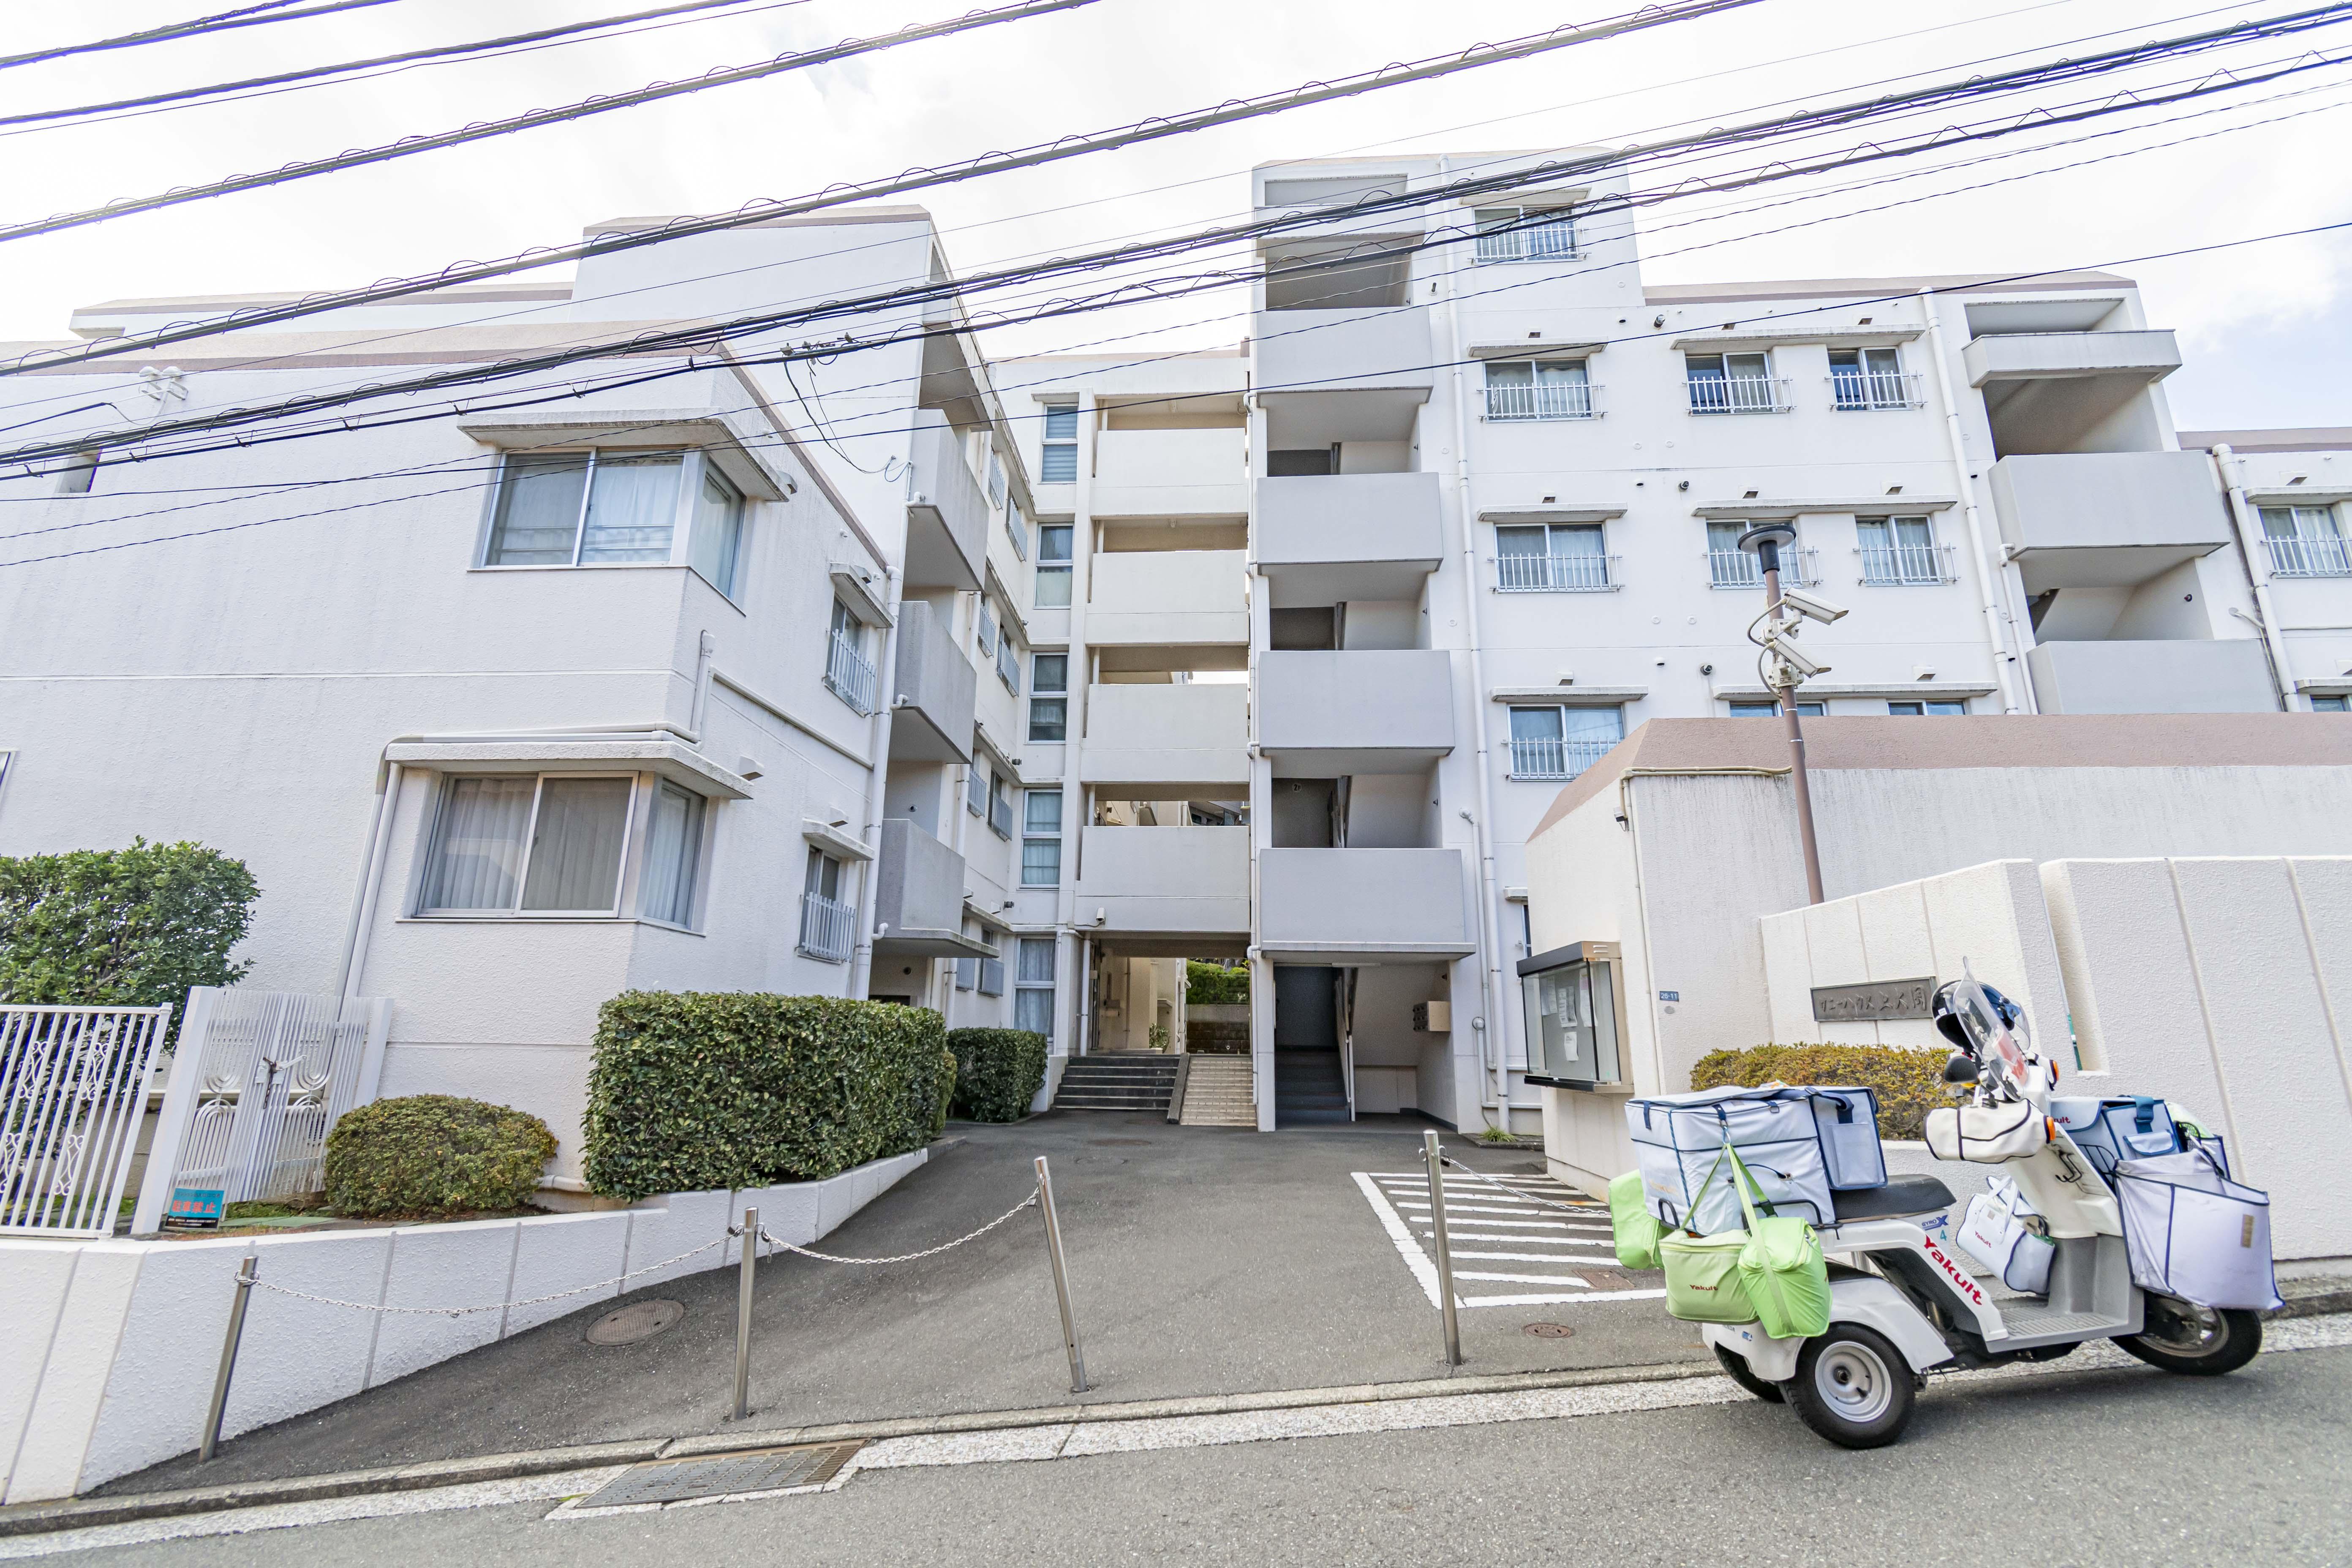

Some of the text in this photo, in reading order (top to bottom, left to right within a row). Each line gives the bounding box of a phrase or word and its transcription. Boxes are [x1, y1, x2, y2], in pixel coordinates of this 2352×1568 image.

[172, 1200, 216, 1213] 駐車禁止
[1940, 1230, 1947, 1241] 4
[1975, 1230, 1992, 1248] Yakult
[1924, 1234, 1982, 1305] Yakult
